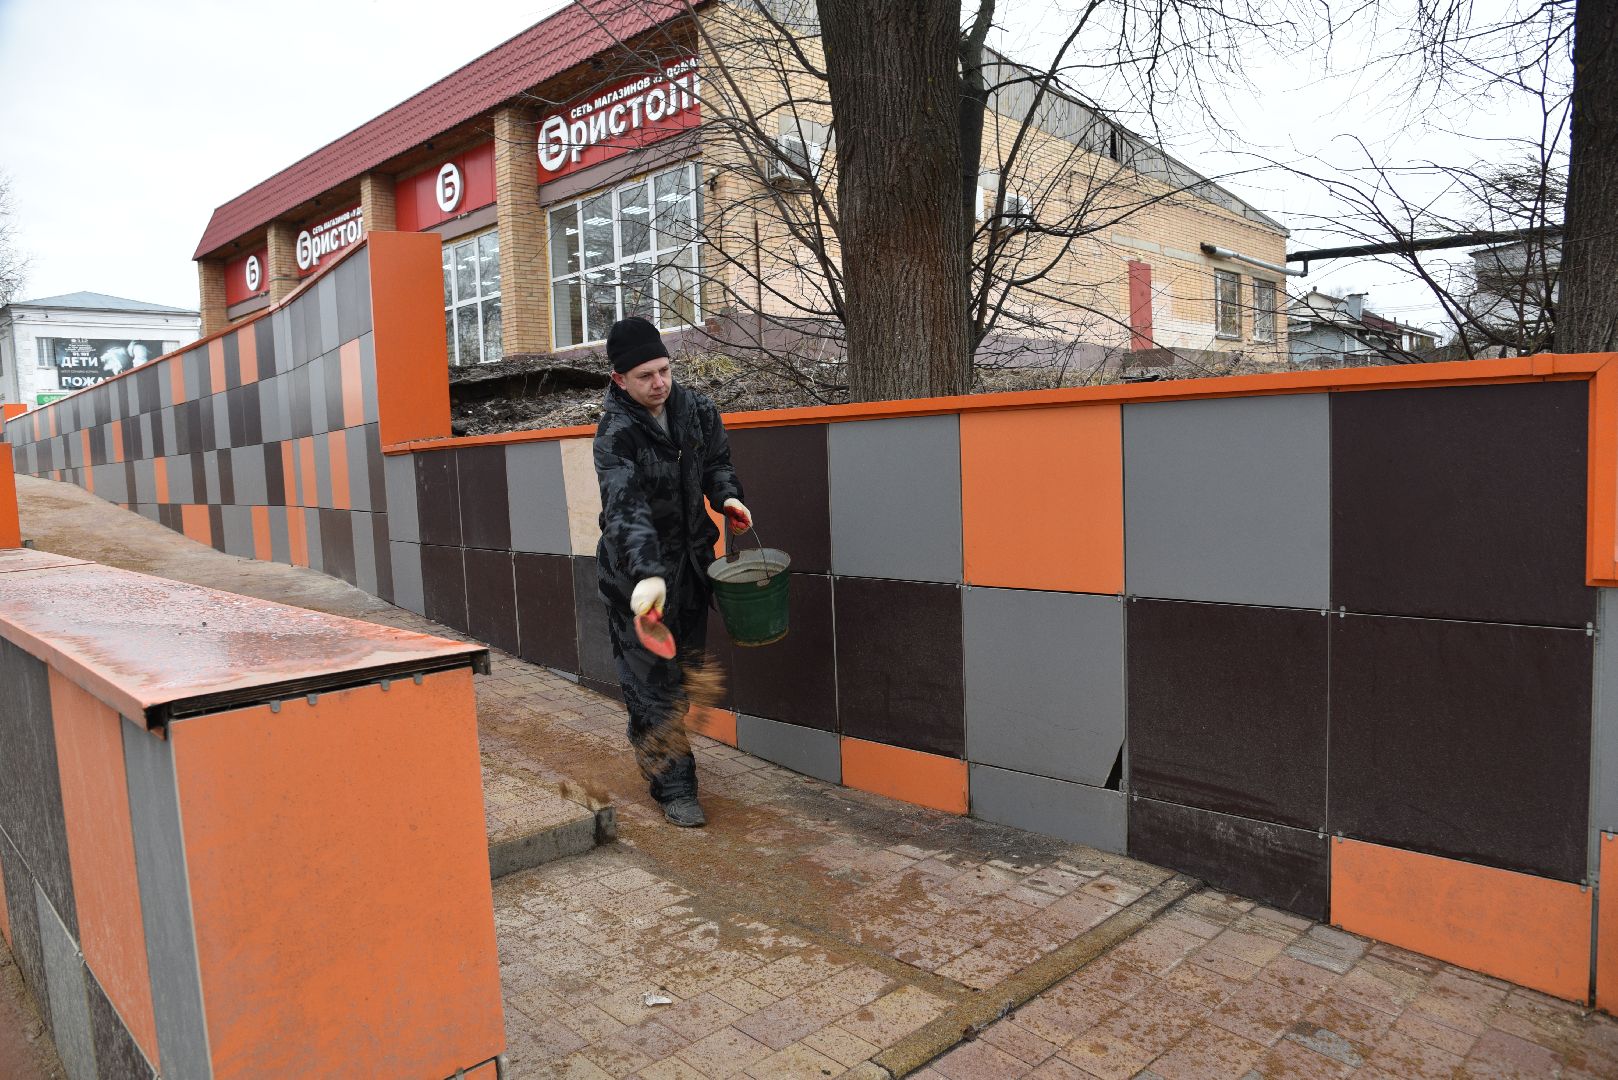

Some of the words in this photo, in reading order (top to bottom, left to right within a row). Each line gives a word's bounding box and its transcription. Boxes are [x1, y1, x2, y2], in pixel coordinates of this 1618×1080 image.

[570, 104, 593, 119] СЕТЬ
[594, 76, 651, 110] МАГАЗИНОВ
[666, 57, 699, 79] ДОМА
[61, 356, 99, 368] ДЕТИ
[61, 376, 110, 387] ПОЖА
